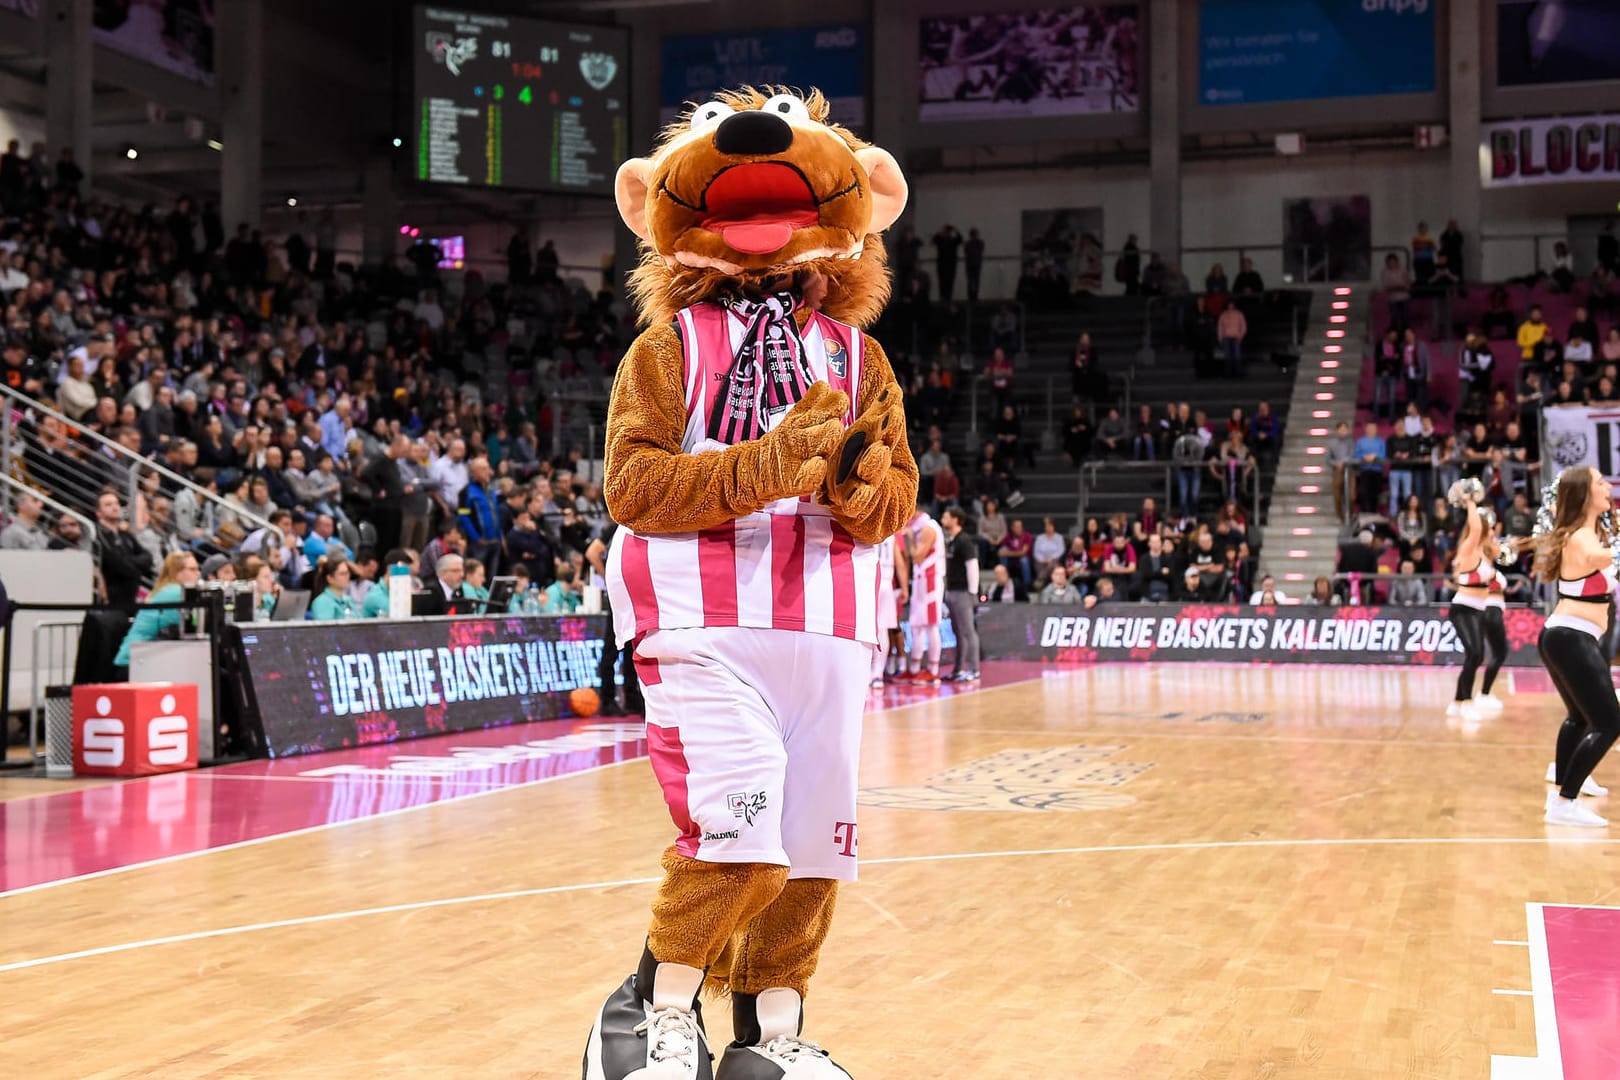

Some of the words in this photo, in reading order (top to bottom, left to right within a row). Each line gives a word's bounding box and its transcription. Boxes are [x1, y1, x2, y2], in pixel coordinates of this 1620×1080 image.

[1040, 616, 1090, 648] DER
[1091, 617, 1155, 648] NEUE
[1156, 618, 1268, 650] BASKETS
[1270, 618, 1402, 650] KALENDER
[326, 653, 380, 716] DER
[377, 647, 441, 709] NEUE
[438, 642, 529, 703] BASKETS
[524, 638, 604, 694] KALENDE
[750, 790, 767, 808] 25
[704, 829, 739, 841] SPALDING
